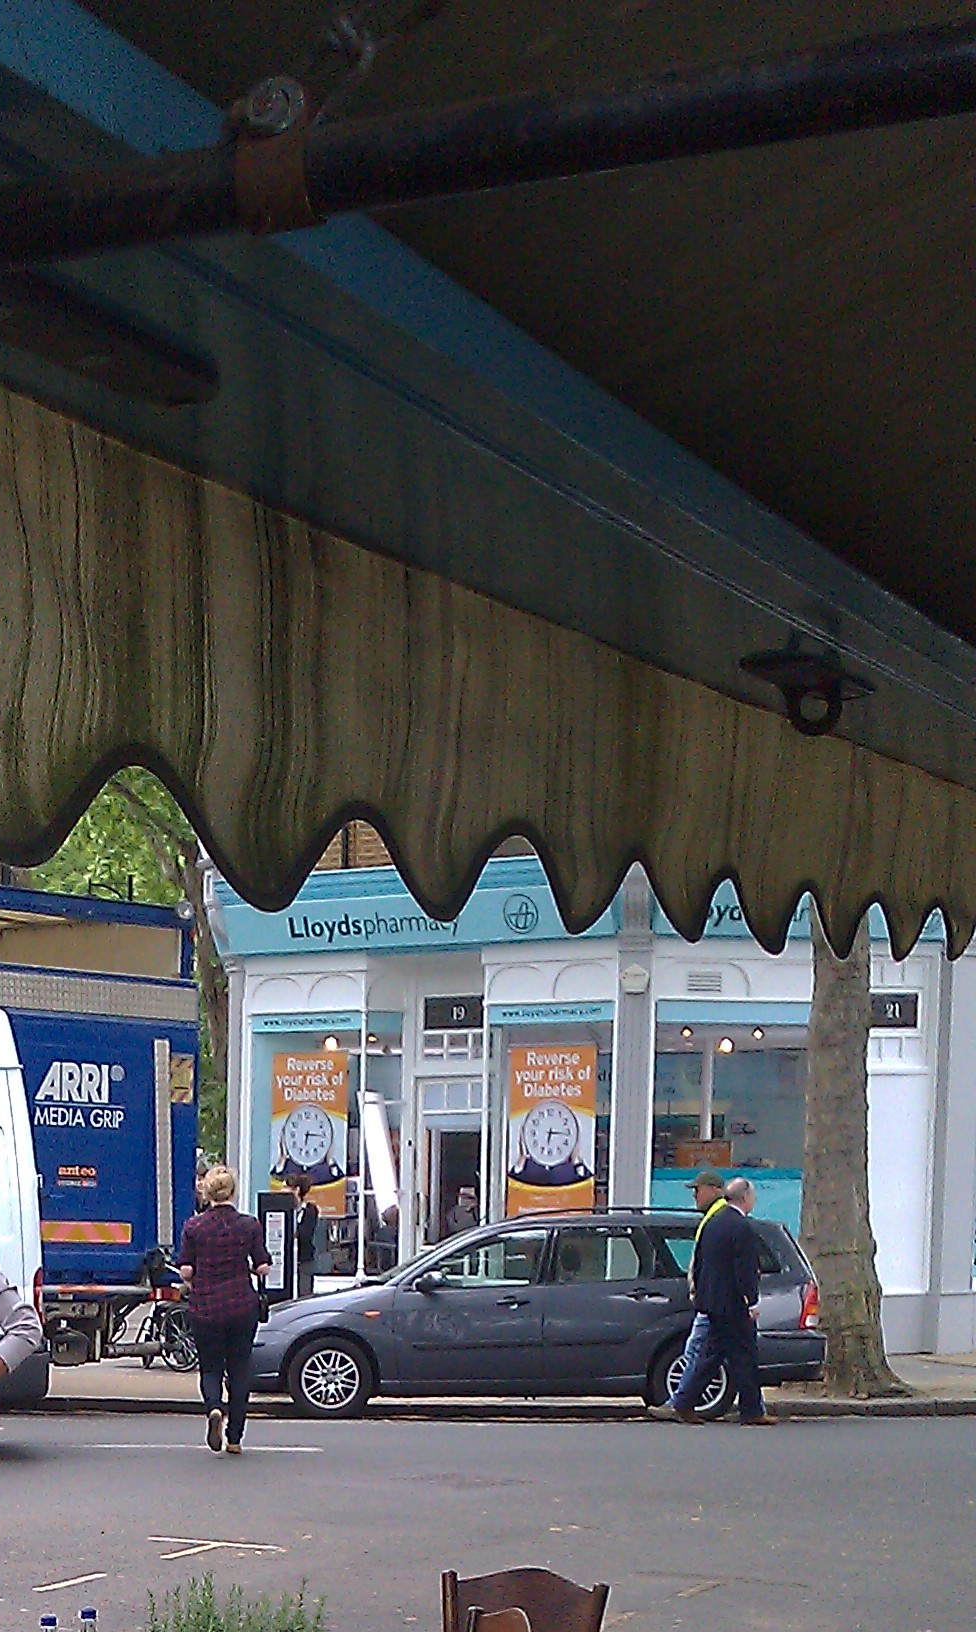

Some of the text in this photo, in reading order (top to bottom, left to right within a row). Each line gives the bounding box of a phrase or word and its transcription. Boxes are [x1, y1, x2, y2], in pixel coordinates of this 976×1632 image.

[452, 1006, 465, 1020] 19
[885, 1002, 900, 1018] 21
[287, 1057, 334, 1072] Reverse
[526, 1051, 581, 1066] Reverse
[276, 1071, 343, 1088] your risk of
[515, 1070, 545, 1084] your
[548, 1066, 574, 1081] risk
[578, 1065, 591, 1080] of
[35, 1061, 109, 1104] ARRI
[284, 1087, 336, 1101] Diabetes
[524, 1083, 582, 1098] Diabetes
[34, 1107, 124, 1128] MEDIA GRIP
